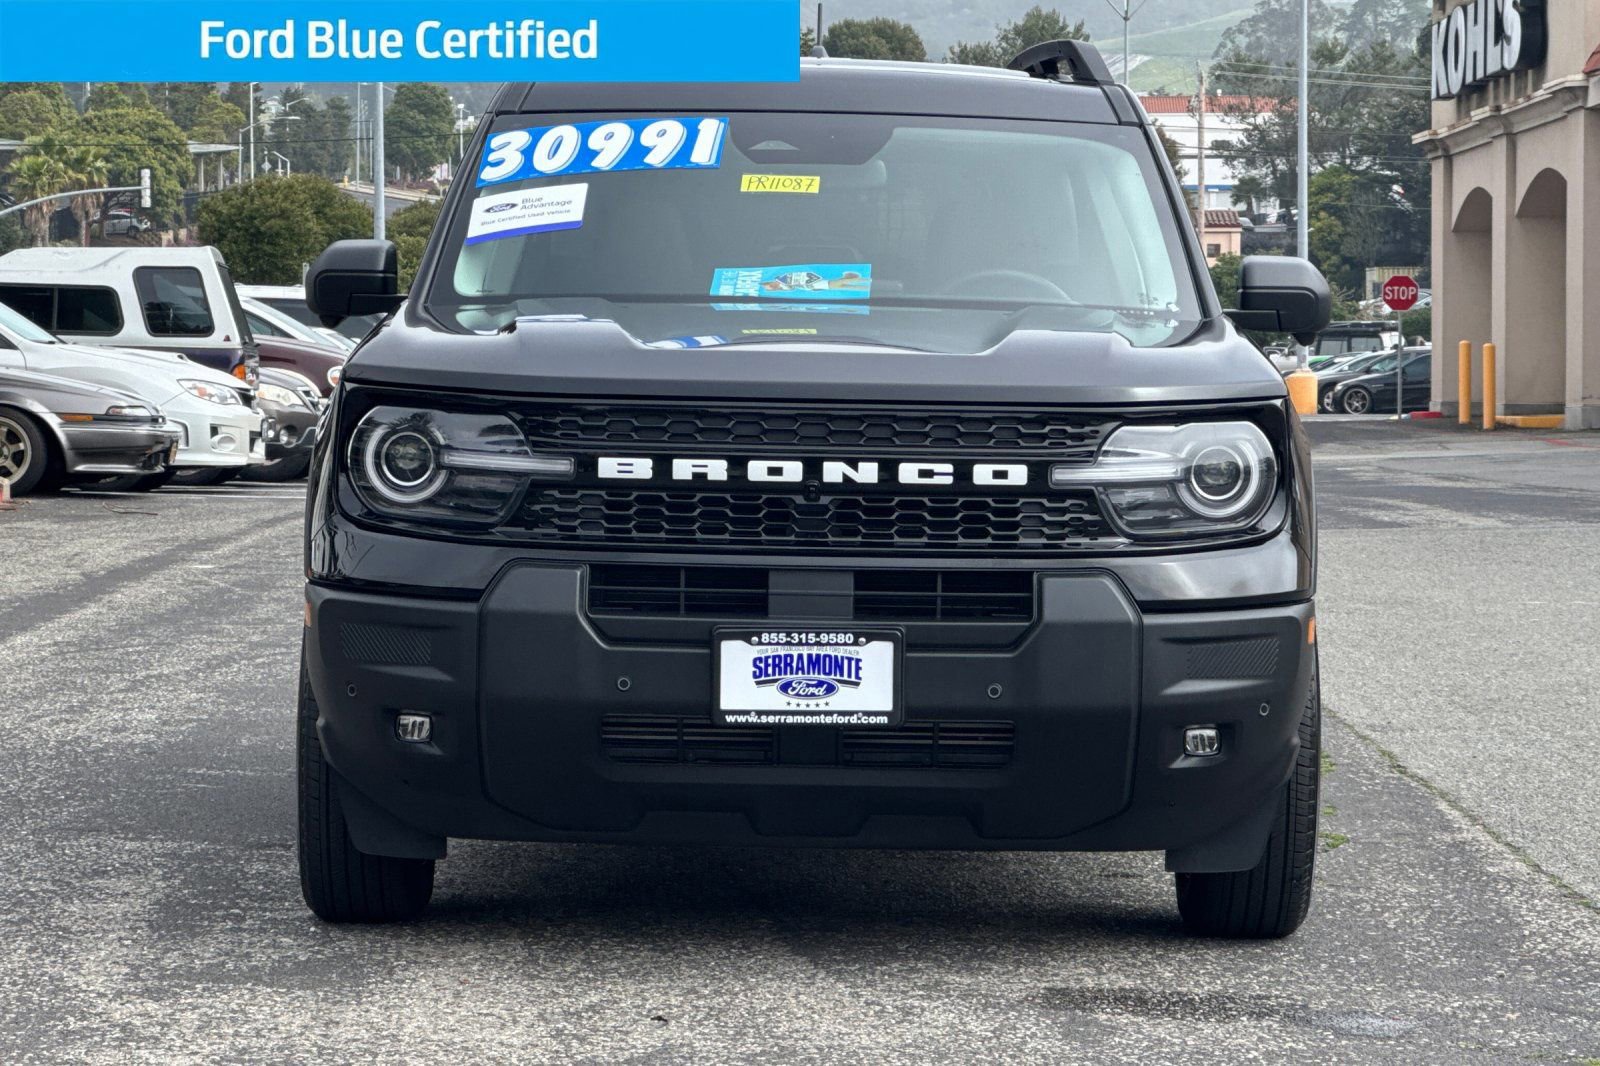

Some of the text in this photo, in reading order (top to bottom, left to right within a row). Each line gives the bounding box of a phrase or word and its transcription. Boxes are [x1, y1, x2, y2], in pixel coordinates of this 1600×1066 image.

[480, 118, 725, 182] 30991
[520, 200, 573, 210] Advantage
[521, 197, 544, 205] Blue
[497, 214, 526, 223] Certified
[1384, 286, 1417, 300] STOP
[598, 457, 1028, 485] BRONCO
[761, 633, 854, 644] 855-315-9580
[752, 653, 863, 681] SERRAMONTE
[787, 680, 827, 696] Ford
[725, 713, 888, 724] www.serramonteford.com
